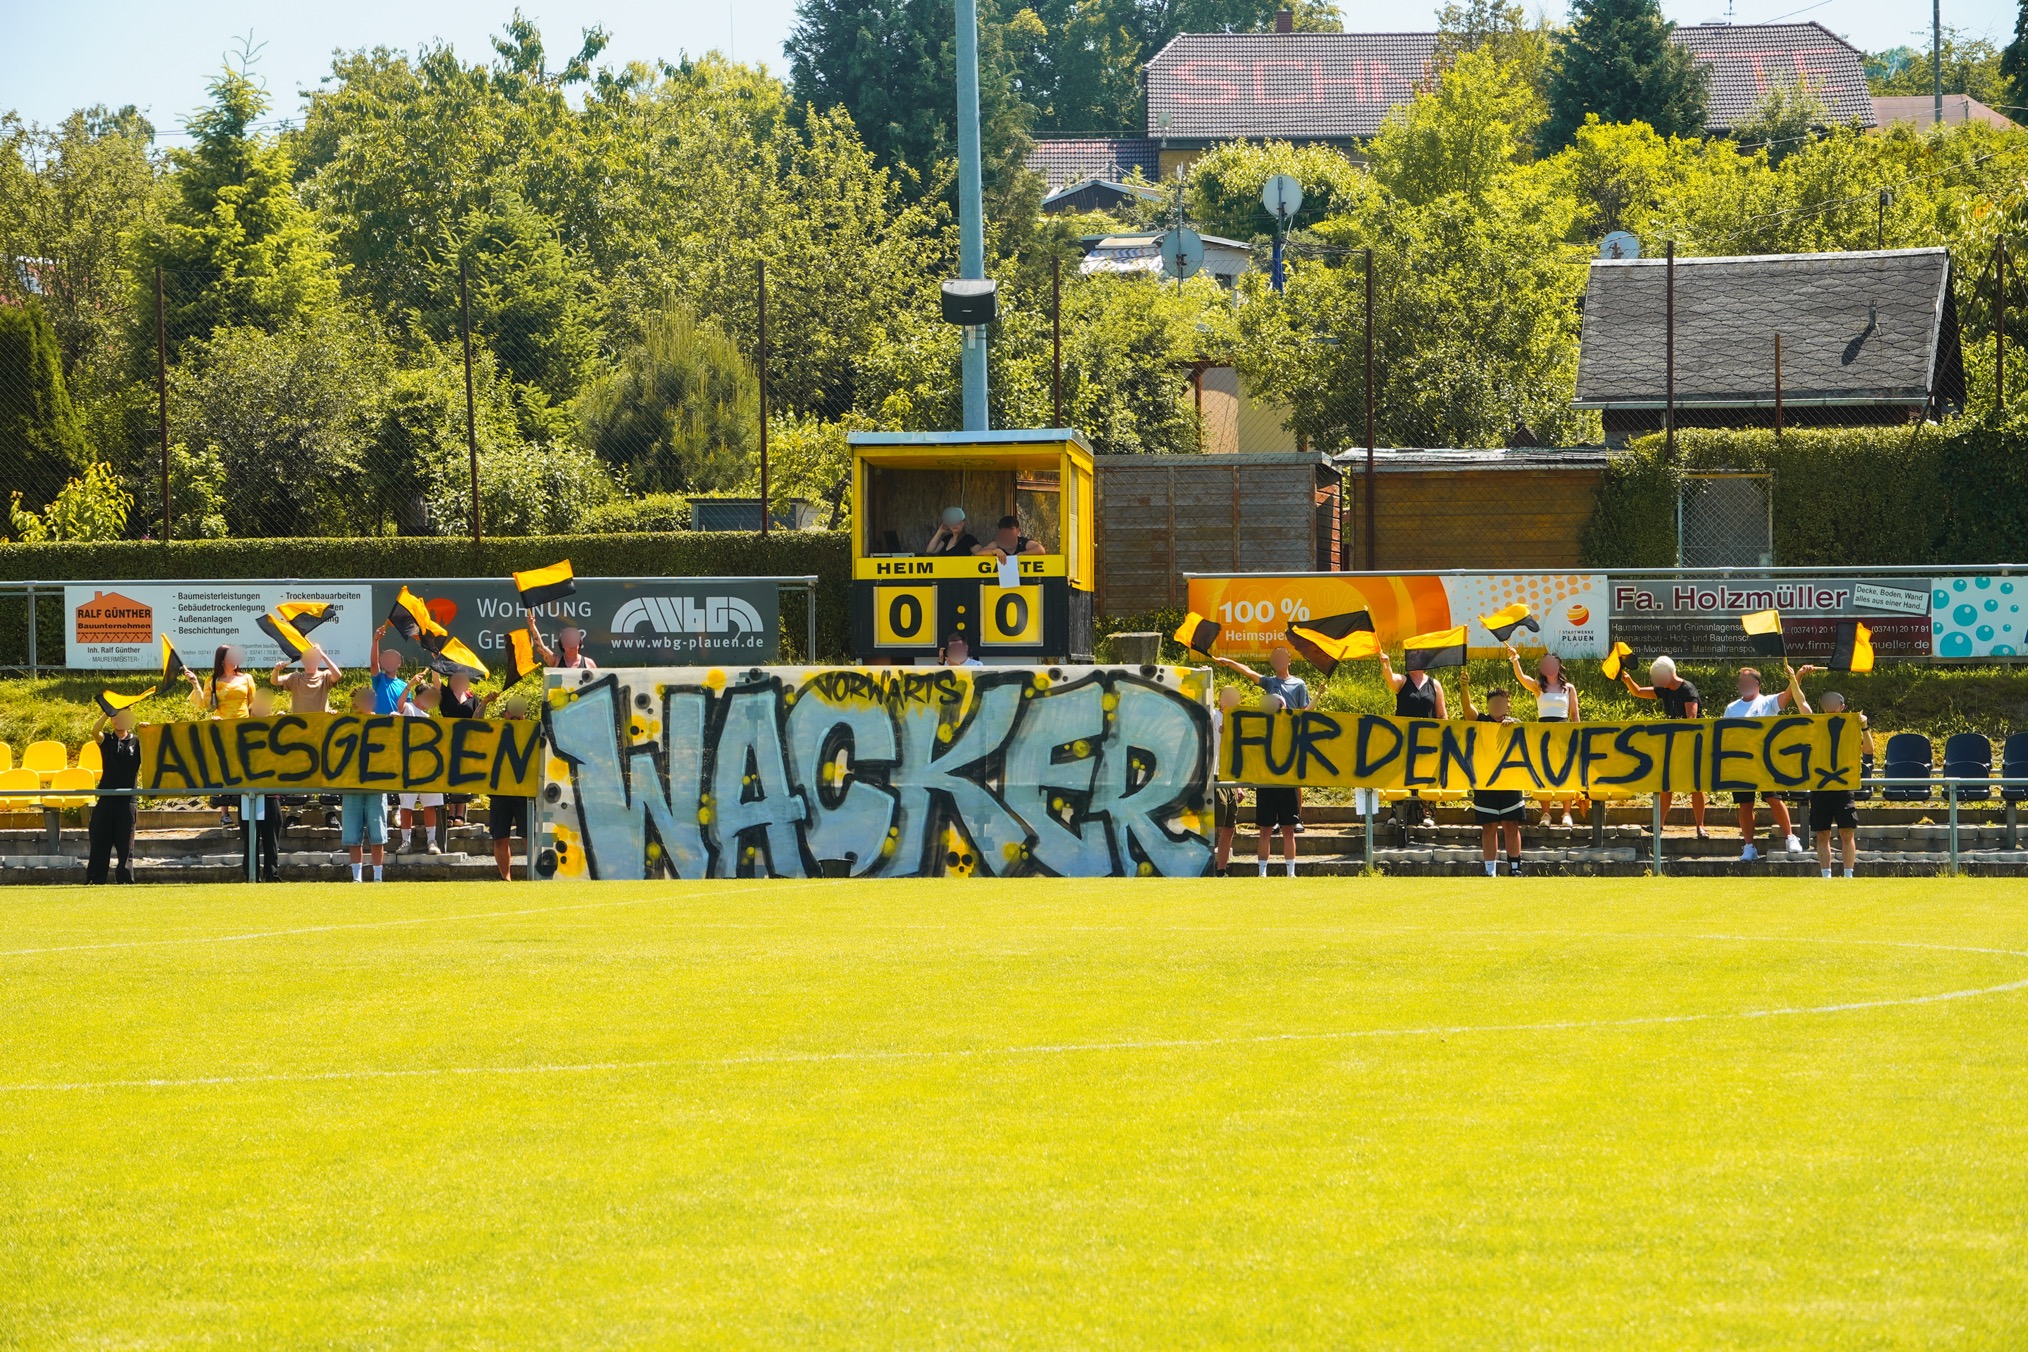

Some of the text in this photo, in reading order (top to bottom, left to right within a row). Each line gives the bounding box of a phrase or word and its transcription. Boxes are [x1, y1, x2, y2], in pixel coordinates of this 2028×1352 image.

[877, 562, 933, 574] HEIM
[178, 592, 260, 601] Baumeisterleistungen
[286, 592, 361, 600] Trockenbauarbeiten
[1614, 584, 1850, 611] Fa. Holzmüller
[1856, 586, 1923, 601] Decke, Boden, Wand
[1855, 595, 1871, 603] alles
[1871, 597, 1884, 605] aus
[1885, 599, 1902, 607] einer
[77, 607, 151, 619] RALF GÜNTHER
[178, 603, 266, 613] Gebäudetrockenlegung
[1219, 598, 1310, 623] 100 %
[178, 615, 233, 624] Außenanlagen
[889, 594, 922, 637] 0
[995, 593, 1028, 636] 0
[178, 626, 240, 635] Beschichtungen
[1611, 622, 1744, 633] Hausmeister- und Grünanlagense
[1791, 625, 1817, 634] (03741)
[1818, 625, 1828, 634] 20
[1871, 625, 1929, 634] (03741) 20 17 91
[611, 636, 764, 651] www.wbg-plauen.de
[1669, 634, 1690, 642] Holz-
[1692, 634, 1707, 642] und
[87, 646, 141, 654] Inh. Ralf Günther
[1355, 714, 1476, 788] DEN
[1487, 717, 1852, 785] AUFSTIEG!
[544, 671, 1215, 878] WACKER
